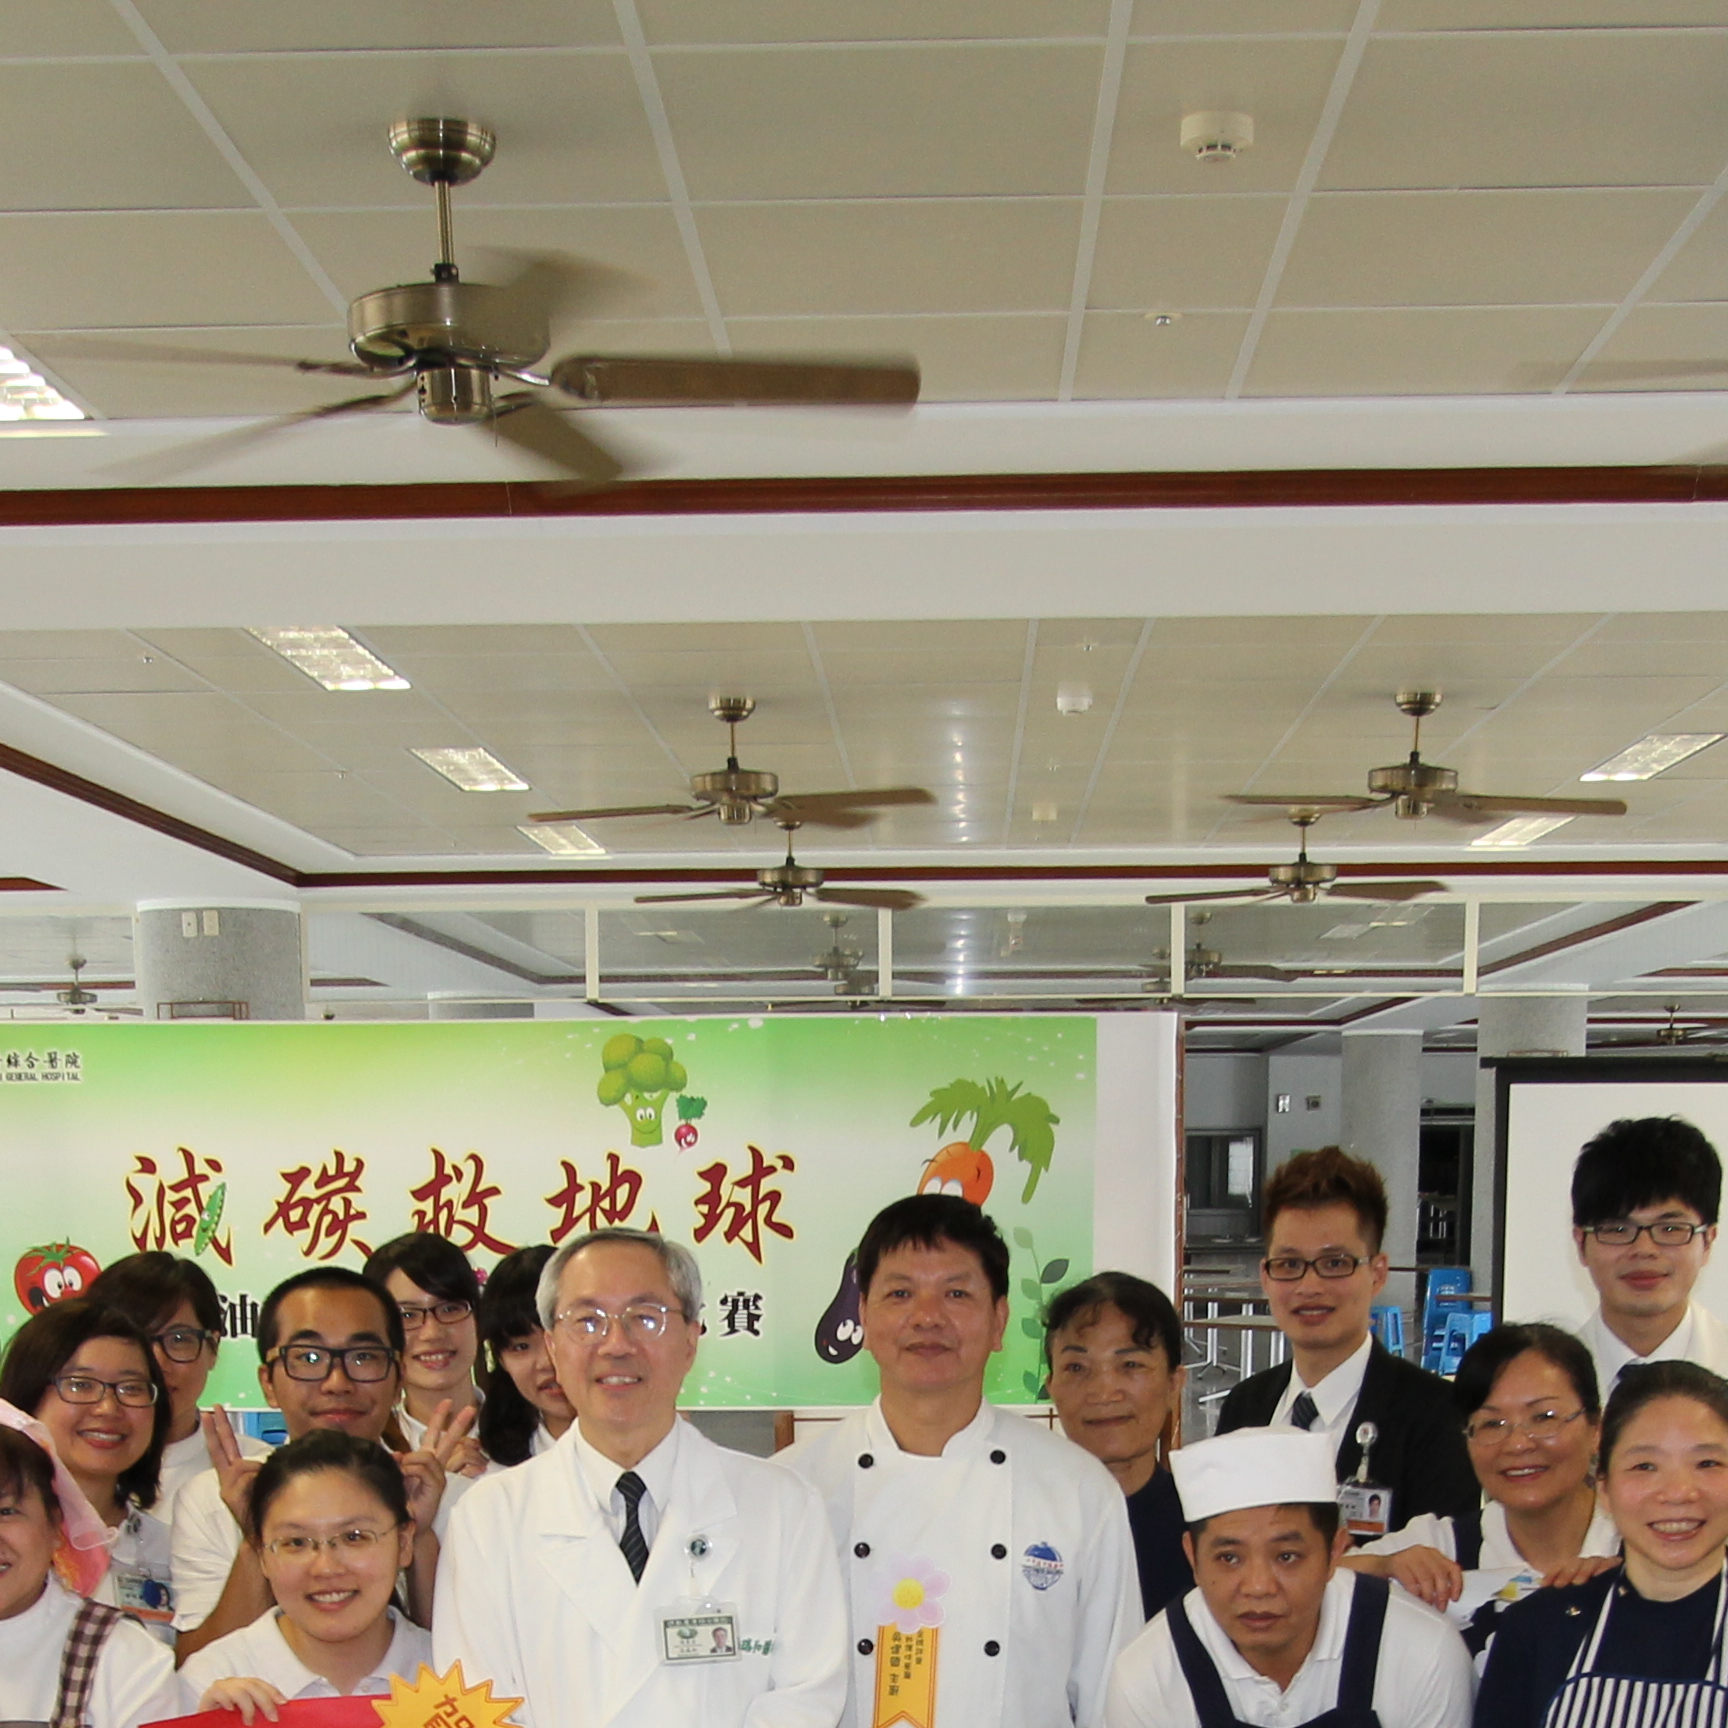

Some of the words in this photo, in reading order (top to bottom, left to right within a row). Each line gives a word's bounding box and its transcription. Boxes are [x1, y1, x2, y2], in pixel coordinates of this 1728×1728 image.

[6, 1073, 38, 1081] GENERAL
[42, 1073, 81, 1081] HOSPITAL
[126, 1145, 797, 1266] 減碳救地球
[699, 1290, 763, 1337] 賽
